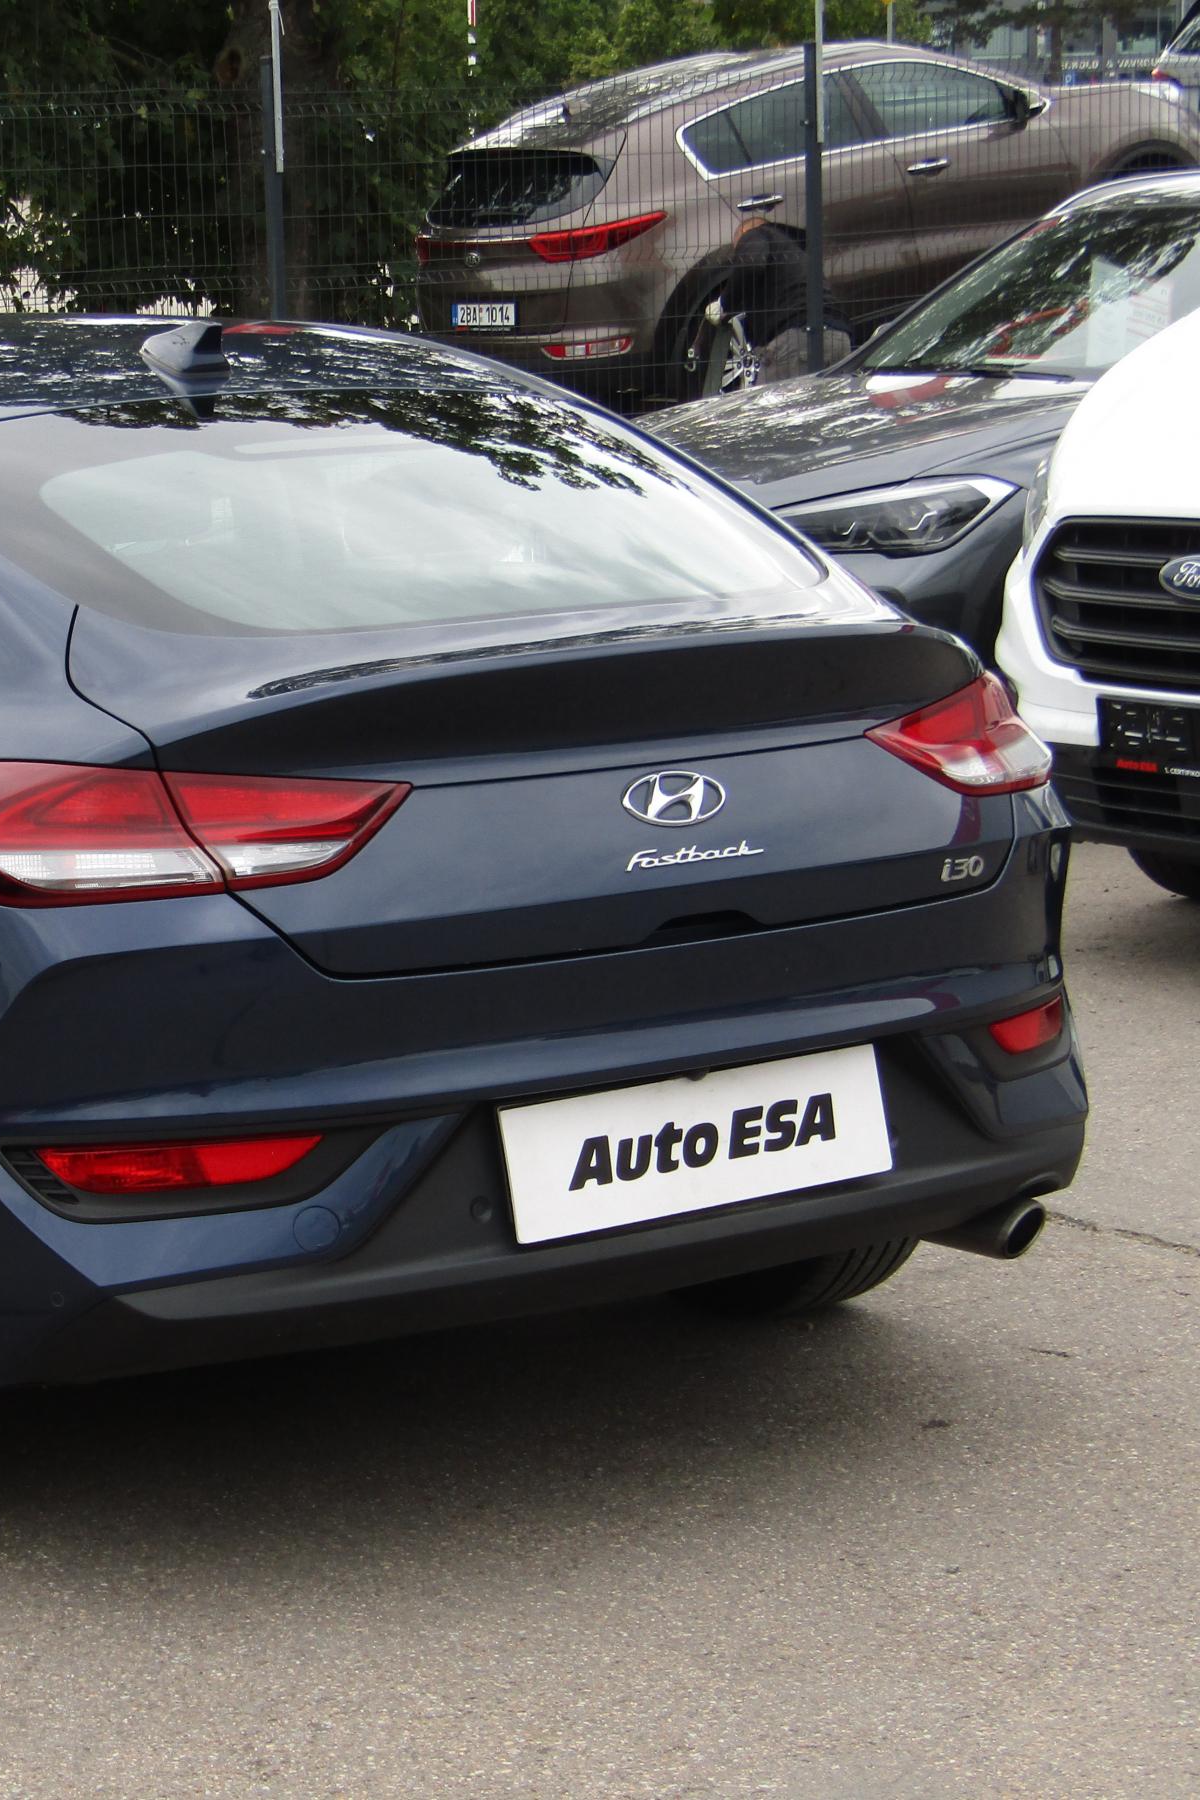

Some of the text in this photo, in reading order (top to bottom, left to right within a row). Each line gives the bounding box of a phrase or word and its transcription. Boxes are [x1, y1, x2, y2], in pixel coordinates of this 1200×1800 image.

[460, 306, 509, 323] 2BA 1014
[625, 839, 764, 872] Fastback
[940, 855, 984, 882] i30
[568, 1092, 836, 1192] Auto ESA
